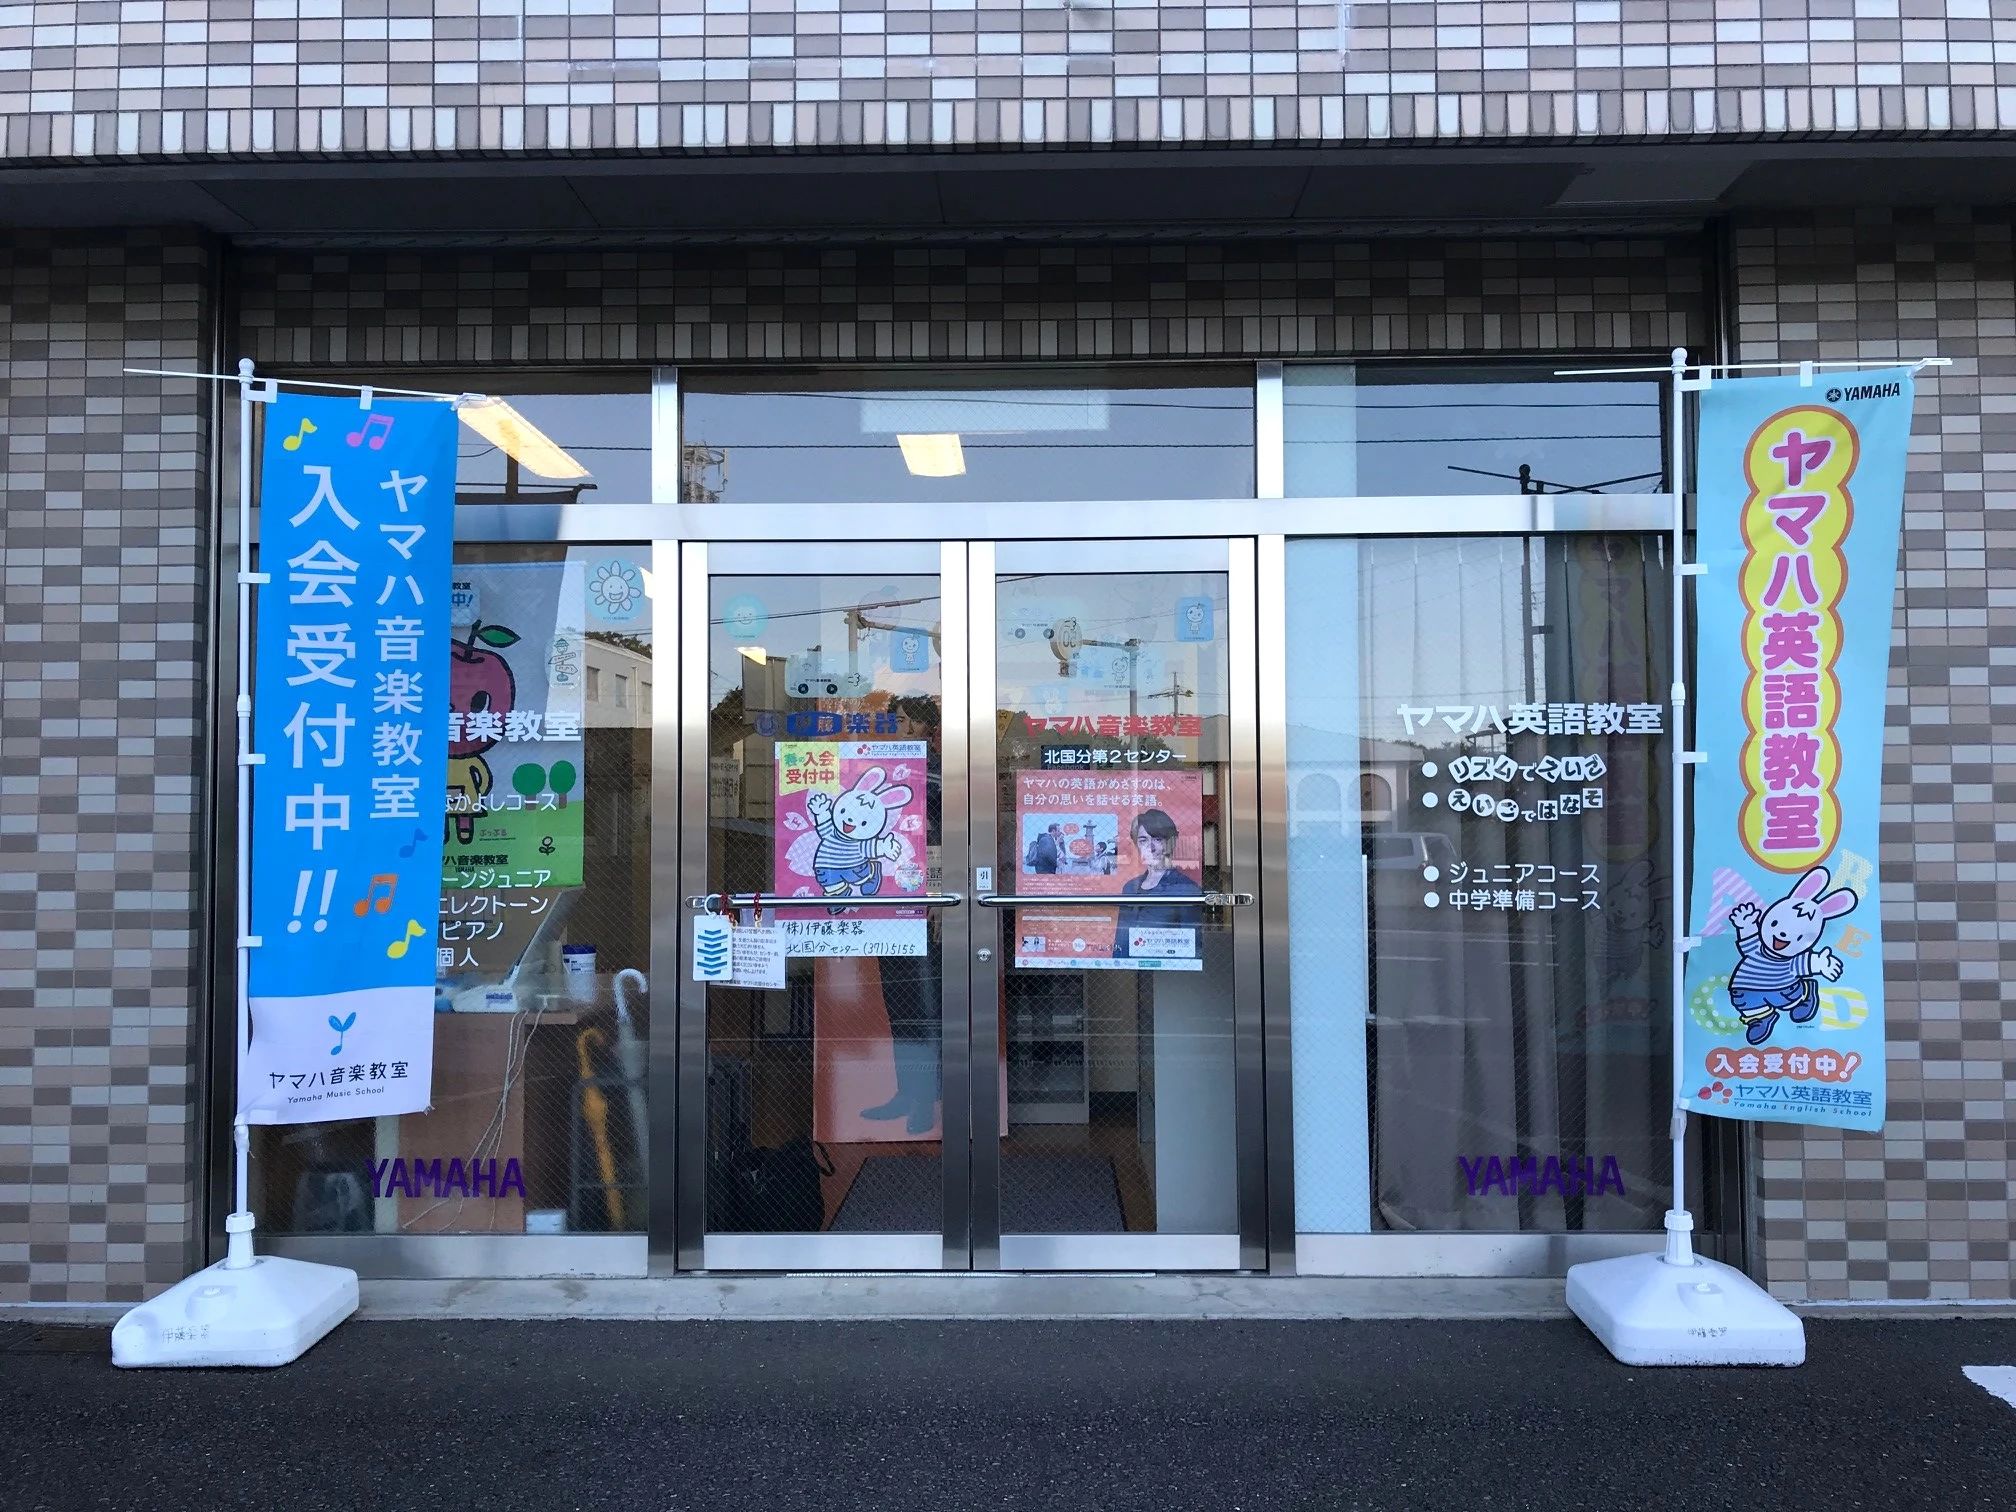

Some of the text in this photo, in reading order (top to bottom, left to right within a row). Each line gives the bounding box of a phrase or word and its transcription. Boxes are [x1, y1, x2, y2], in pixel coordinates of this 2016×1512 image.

[1844, 383, 1901, 401] YAMAHA
[370, 469, 428, 819] ヤマハ音楽教室
[1763, 431, 1832, 850] ヤマハ英語教室
[283, 465, 361, 934] 入会受付中!!
[1023, 714, 1204, 738] ヤマハ音楽教室
[1397, 702, 1664, 735] ヤマハ英語教室
[1044, 748, 1187, 765] 北国分第2センター
[786, 768, 835, 784] 受付中
[1449, 754, 1607, 783] リズムでえいご
[1024, 777, 1172, 791] ヤマハの英語がめざすのは、
[1024, 793, 1163, 807] 自分の思いを話せる英語。
[1450, 861, 1600, 883] ジュニアコース
[1449, 889, 1601, 911] 中学準備コース
[442, 921, 504, 941] ピアノ
[1835, 924, 1872, 958] E
[269, 1060, 409, 1089] ヤマハ音楽教室
[1713, 1052, 1858, 1079] 入会受付中!
[288, 1086, 385, 1104] Yamaha Music School
[1735, 1084, 1873, 1105] ヤマハ英語教室
[1733, 1101, 1872, 1117] Yamaha English School
[364, 1157, 527, 1198] YAMAHA
[1457, 1155, 1626, 1197] YAMAHA
